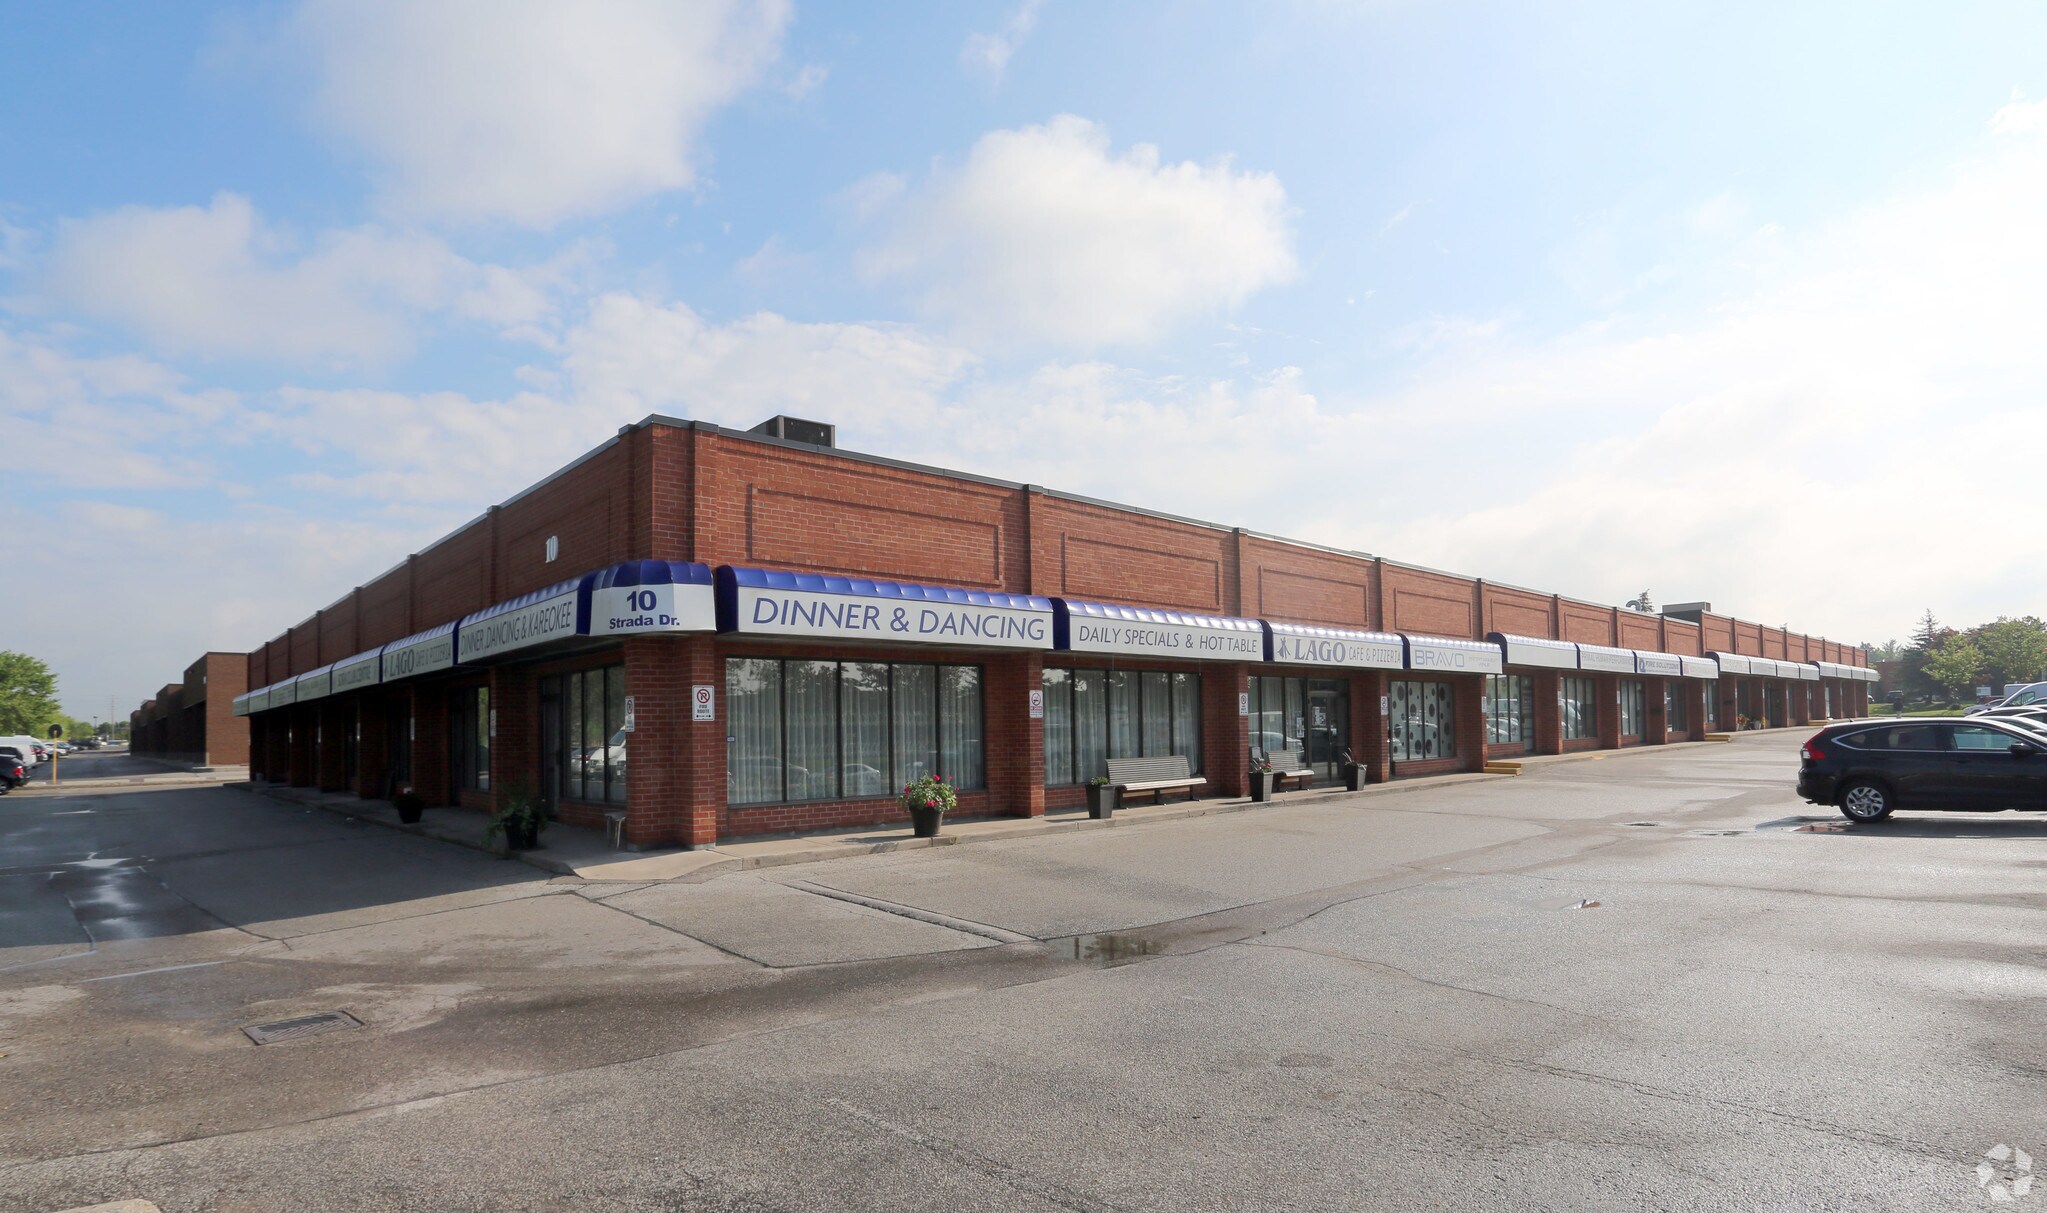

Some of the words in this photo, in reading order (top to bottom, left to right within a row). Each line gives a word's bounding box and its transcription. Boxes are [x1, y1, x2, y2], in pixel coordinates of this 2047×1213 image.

[545, 535, 559, 563] 10
[626, 590, 657, 612] 10
[486, 617, 520, 649] DANCING
[521, 615, 527, 640] &
[527, 601, 572, 637] KAREOKEE
[609, 615, 654, 630] Strada
[659, 614, 680, 626] Dr.
[752, 597, 880, 630] DINNER
[890, 607, 910, 632] &
[918, 609, 1045, 641] DANCING
[1079, 625, 1122, 644] DAILY
[1124, 629, 1179, 648] SPECIALS
[1185, 633, 1194, 649] &
[1200, 635, 1225, 650] HOT
[1227, 637, 1257, 653] TABLE
[1294, 639, 1346, 663] LAGO
[1348, 647, 1364, 661] CAFE
[1372, 648, 1401, 663] PIZZERIA
[389, 649, 415, 677] LAGO
[1414, 649, 1465, 668] BRAVO
